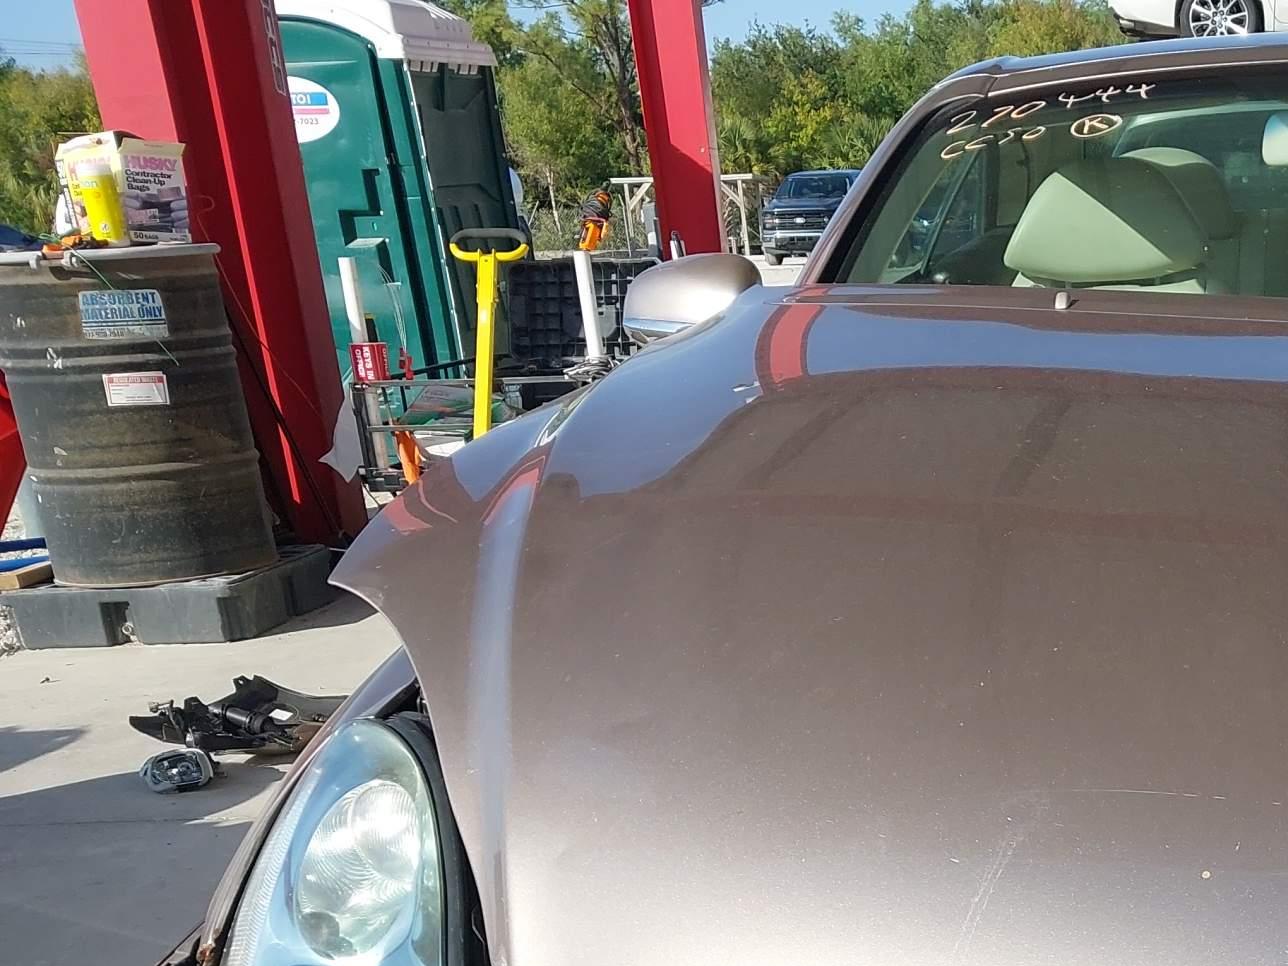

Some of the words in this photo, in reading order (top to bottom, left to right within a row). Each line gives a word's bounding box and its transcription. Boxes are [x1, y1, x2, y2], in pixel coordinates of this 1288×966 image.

[124, 155, 178, 171] HUSKY
[125, 169, 173, 179] Contractor
[126, 177, 166, 187] Clean-Up
[127, 184, 151, 193] Bags
[133, 231, 145, 240] 50
[82, 292, 156, 305] ABSORBENT
[83, 305, 138, 320] MATERIAL
[138, 303, 162, 318] ONLY
[362, 346, 373, 369] KEYS
[367, 370, 375, 380] IN
